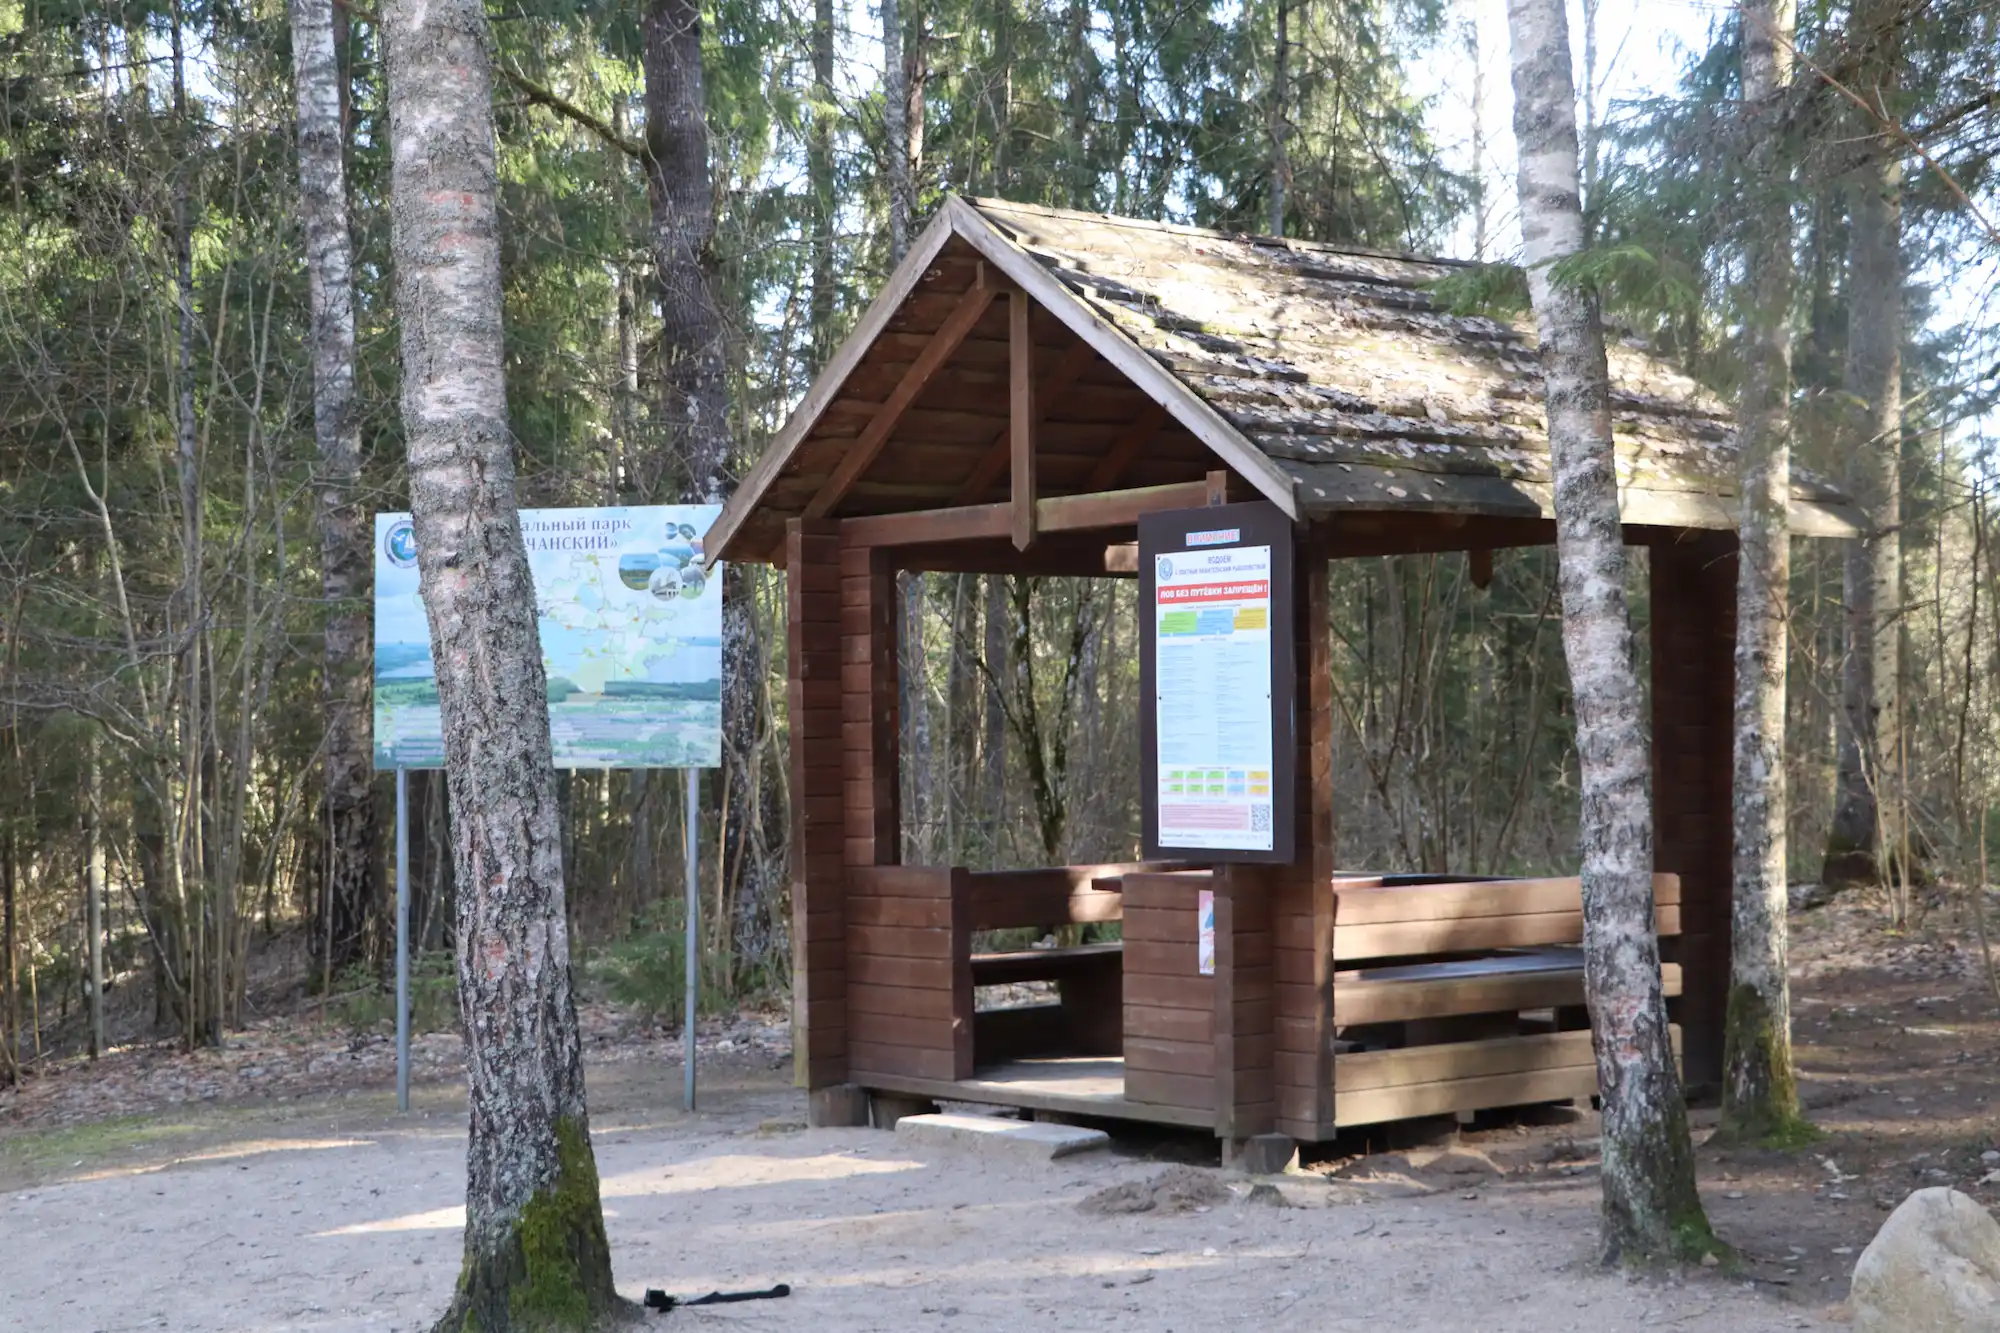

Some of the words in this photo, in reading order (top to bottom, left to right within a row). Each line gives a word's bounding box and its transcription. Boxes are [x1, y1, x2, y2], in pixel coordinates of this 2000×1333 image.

[521, 516, 586, 532] альный
[591, 519, 632, 533] парк
[526, 531, 618, 550] ЧАНСКИЙ»
[1160, 590, 1174, 599] ЛОВ
[1175, 589, 1189, 597] БЕЗ
